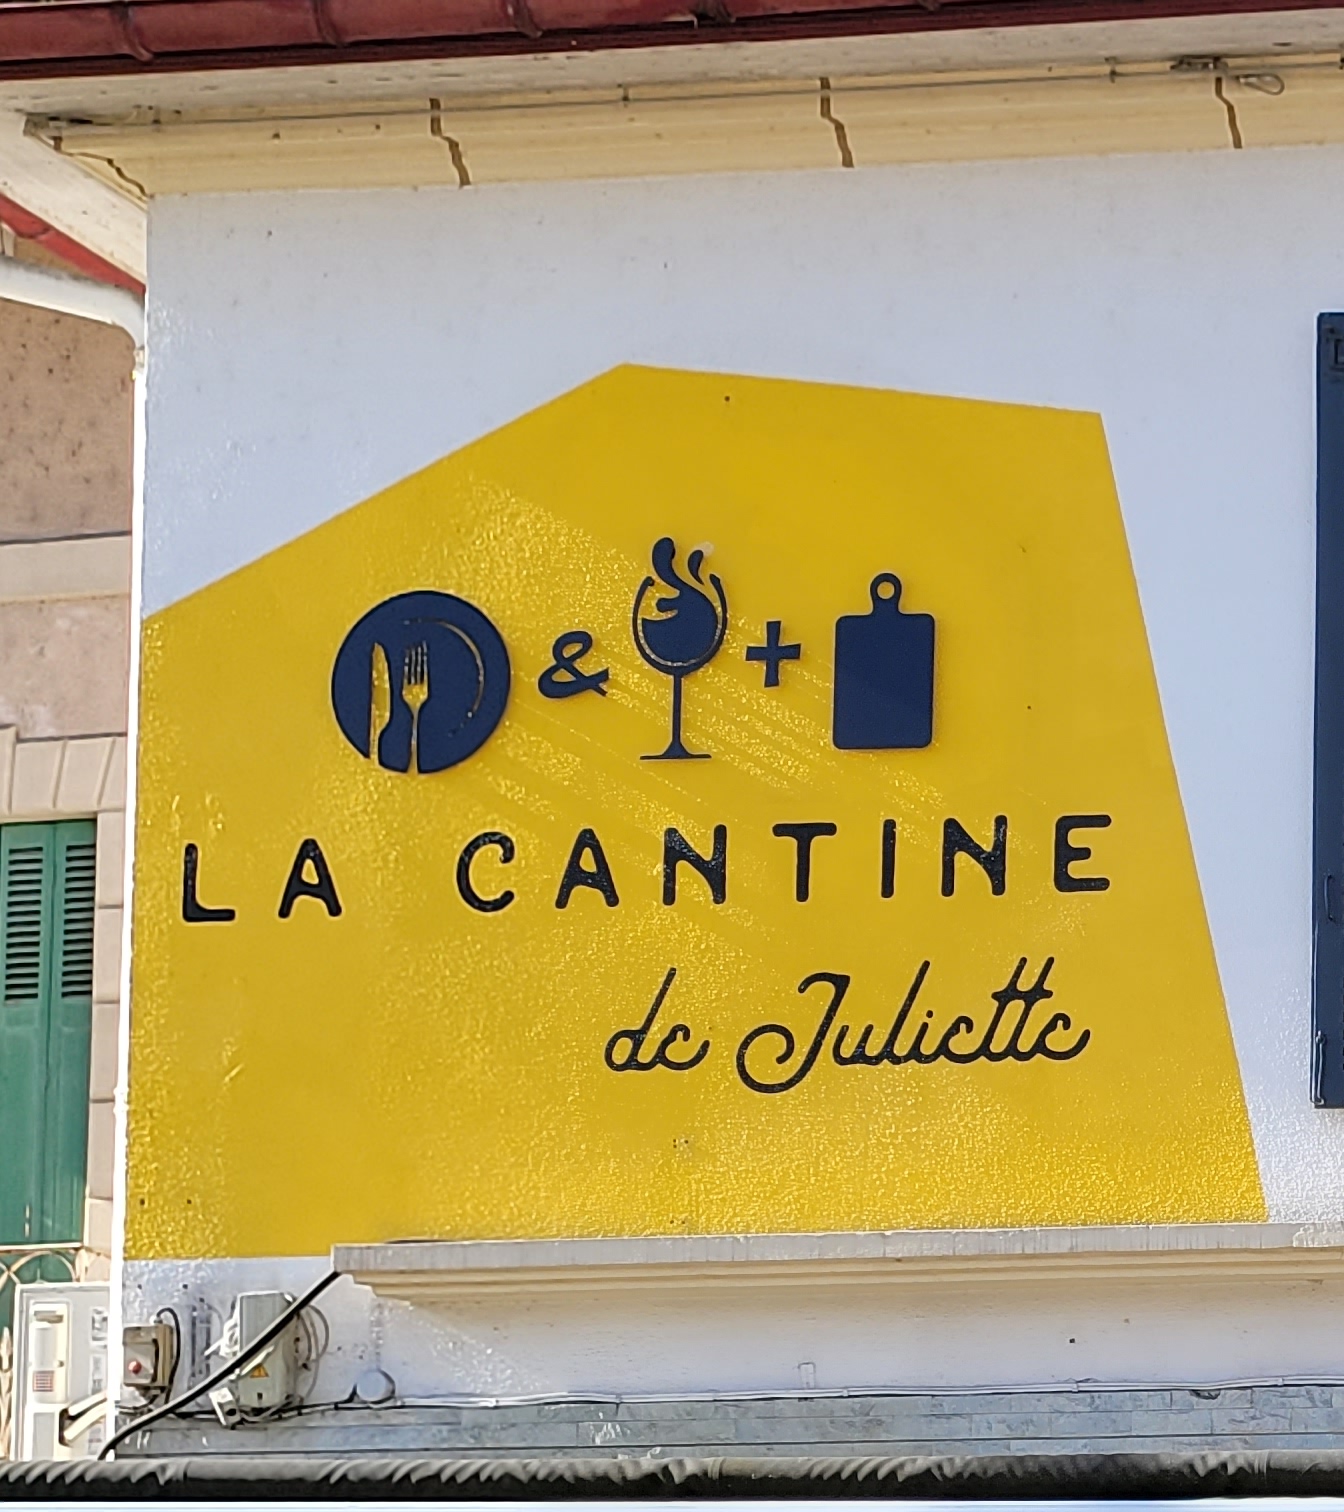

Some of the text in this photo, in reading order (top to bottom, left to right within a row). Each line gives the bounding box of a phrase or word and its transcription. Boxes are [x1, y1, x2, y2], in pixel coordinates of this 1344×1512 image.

[181, 812, 1114, 922] LA CANTINE
[603, 953, 1092, 1096] de Juliette
